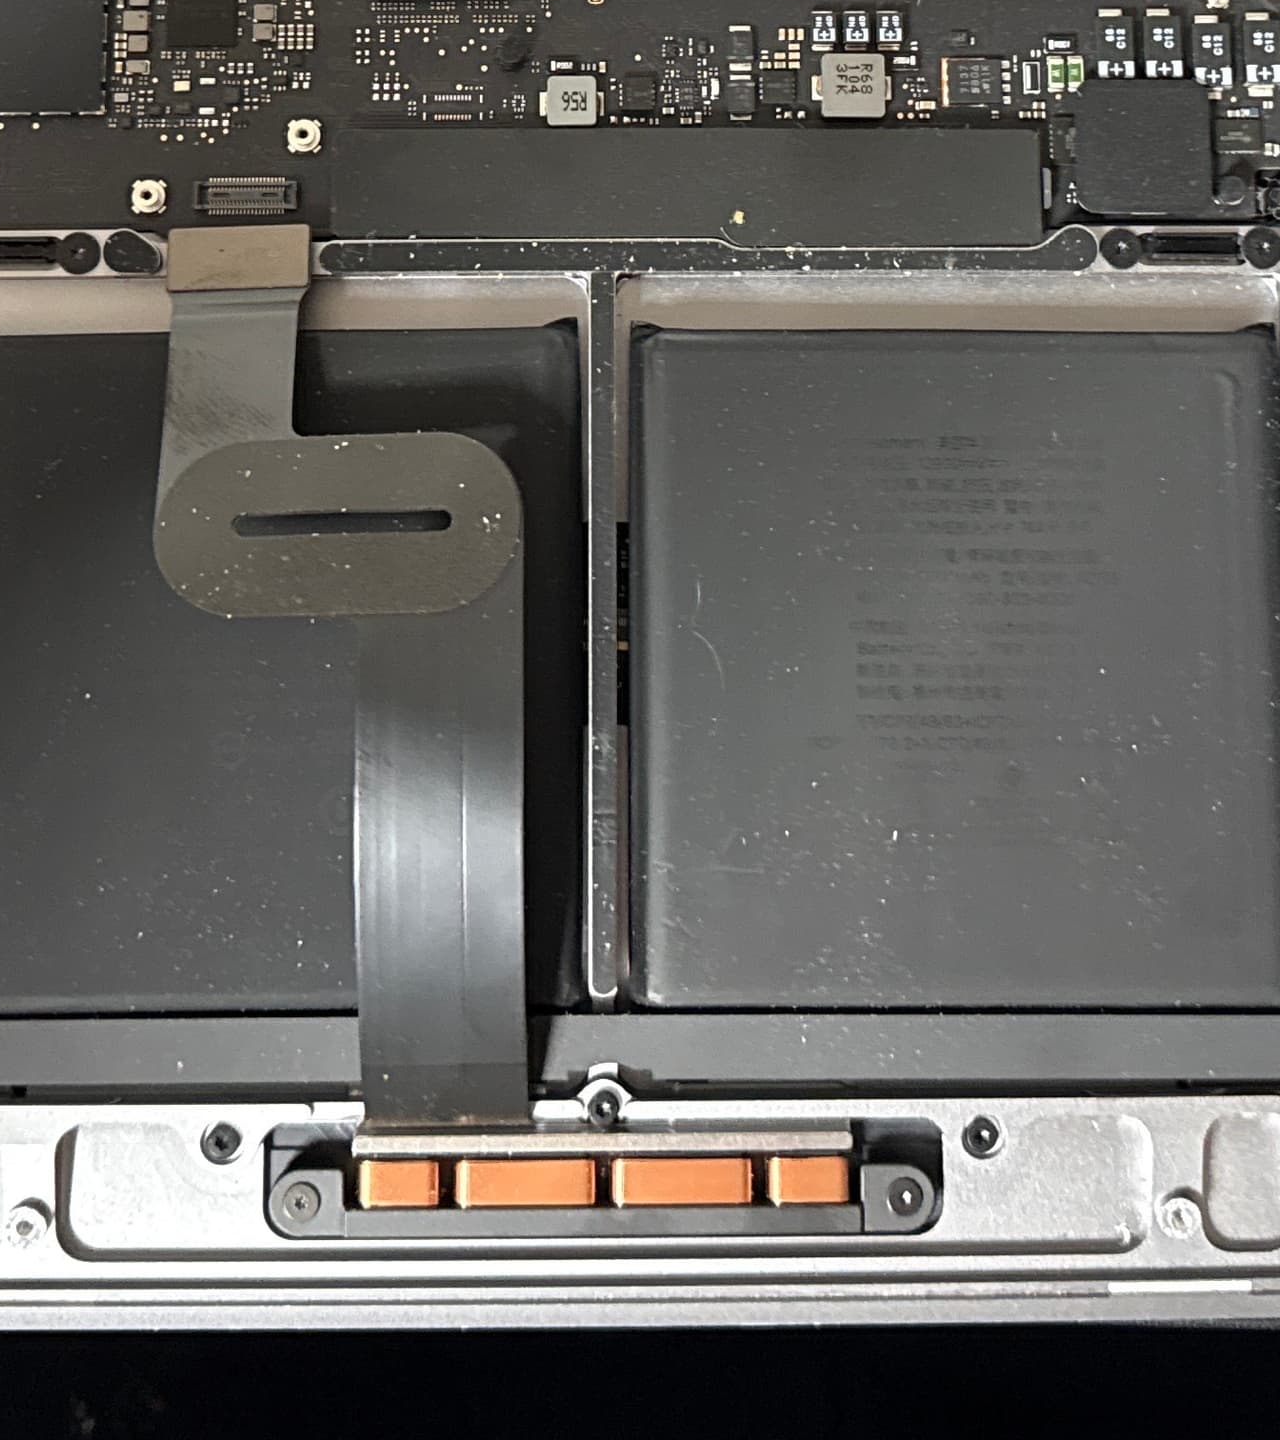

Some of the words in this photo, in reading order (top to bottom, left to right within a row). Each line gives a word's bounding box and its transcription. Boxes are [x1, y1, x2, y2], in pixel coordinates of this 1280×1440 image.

[836, 64, 848, 95] 3FK
[849, 66, 860, 94] 104
[861, 64, 873, 94] R68
[562, 91, 587, 111] R56
